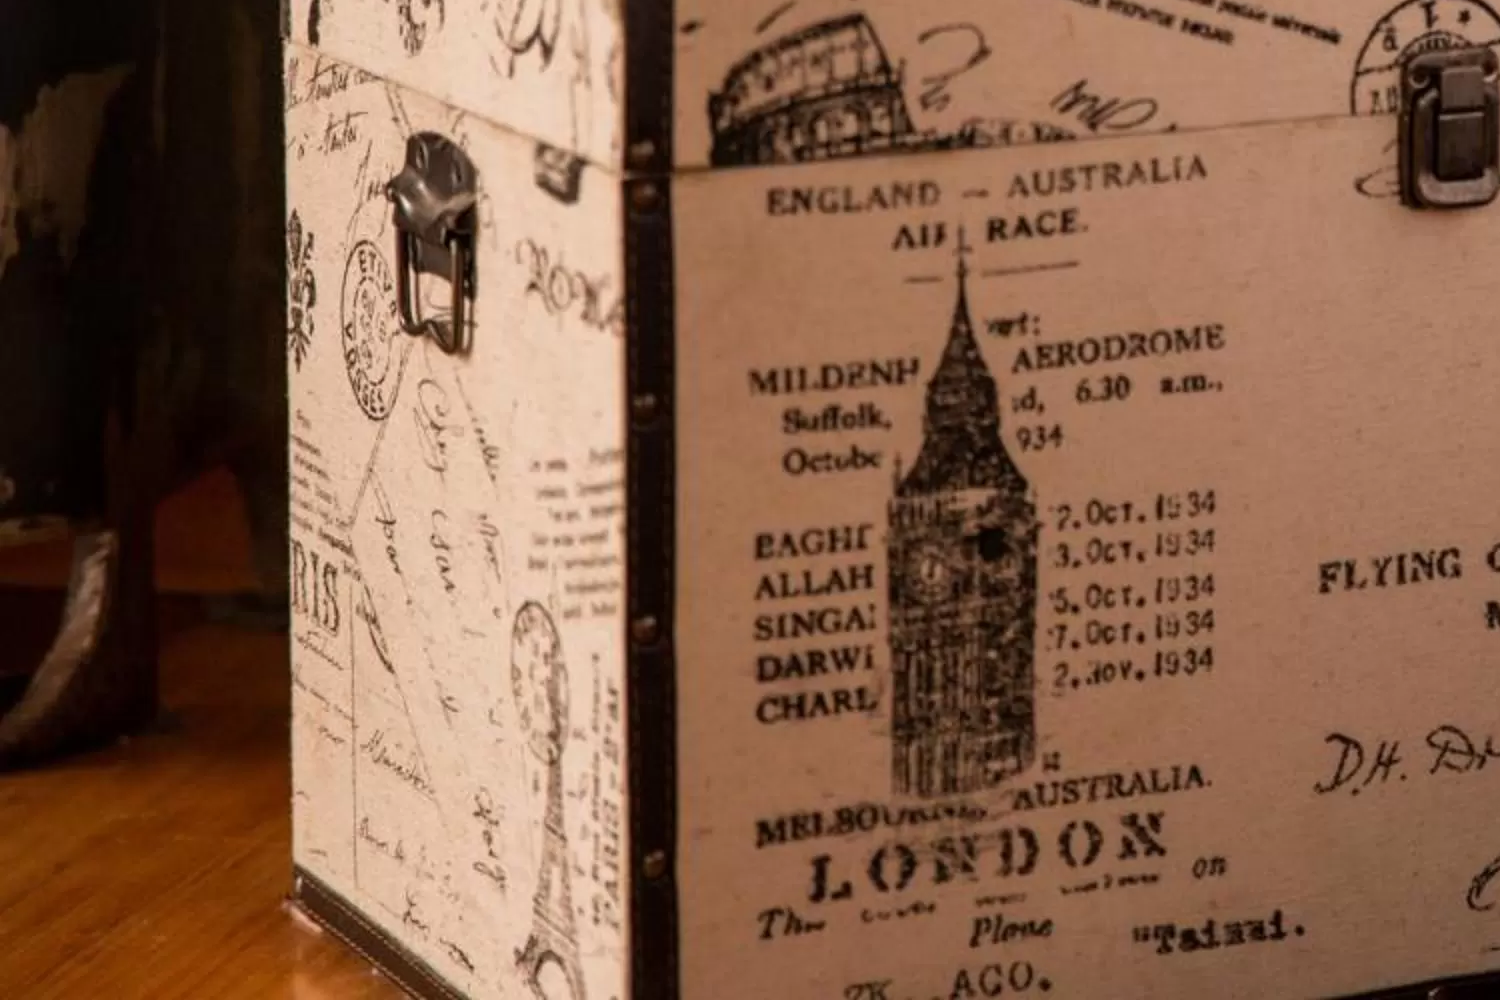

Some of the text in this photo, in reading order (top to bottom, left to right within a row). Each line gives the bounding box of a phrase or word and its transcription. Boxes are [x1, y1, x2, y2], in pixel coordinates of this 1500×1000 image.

[766, 180, 941, 217] ENGLAND
[1006, 153, 1209, 199] AUSTRALIA
[986, 206, 1090, 243] RACE.
[1010, 323, 1227, 375] AERODROME
[780, 403, 893, 435] Suffolk,
[1075, 372, 1132, 406] 6.30
[753, 562, 875, 601] ALLAH
[1317, 546, 1463, 595] FLYING
[755, 686, 879, 725] CHARL
[1011, 764, 1214, 813] AUSTRALIA.
[808, 810, 1168, 904] LONDON
[1191, 855, 1228, 880] on
[949, 959, 1053, 999] ACO.
